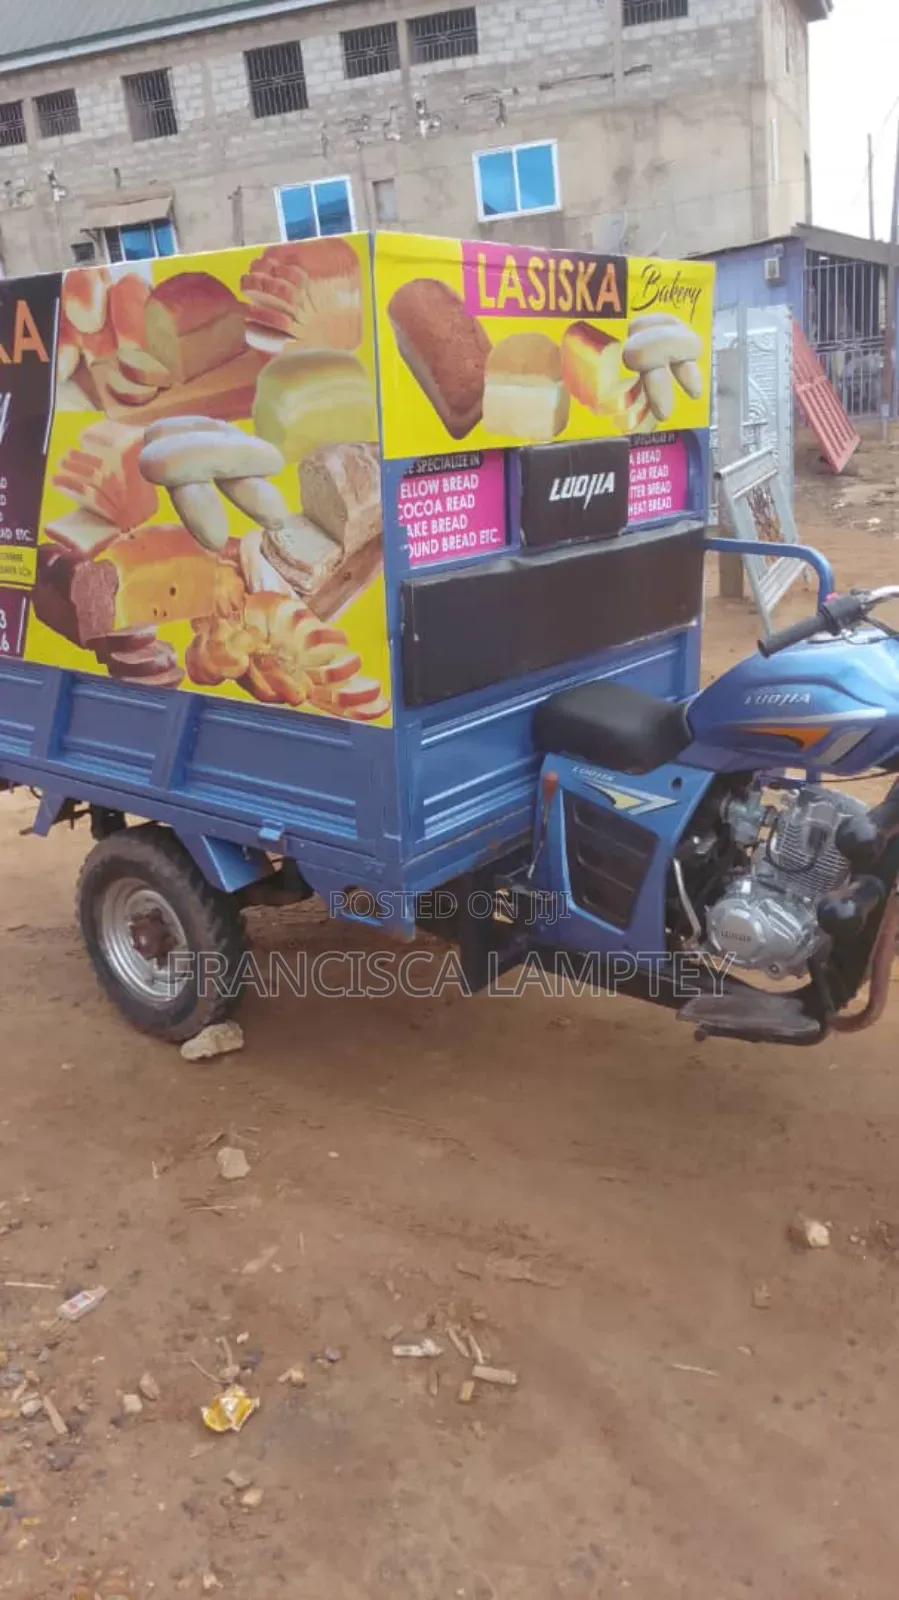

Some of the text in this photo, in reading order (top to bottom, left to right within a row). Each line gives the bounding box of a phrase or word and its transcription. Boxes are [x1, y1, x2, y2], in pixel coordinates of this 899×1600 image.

[477, 253, 703, 323] LASISKA Bakery
[0, 299, 50, 364] A
[442, 474, 479, 493] BREAD
[446, 494, 475, 512] READ
[431, 514, 468, 535] BREAD
[441, 531, 477, 552] BREAD
